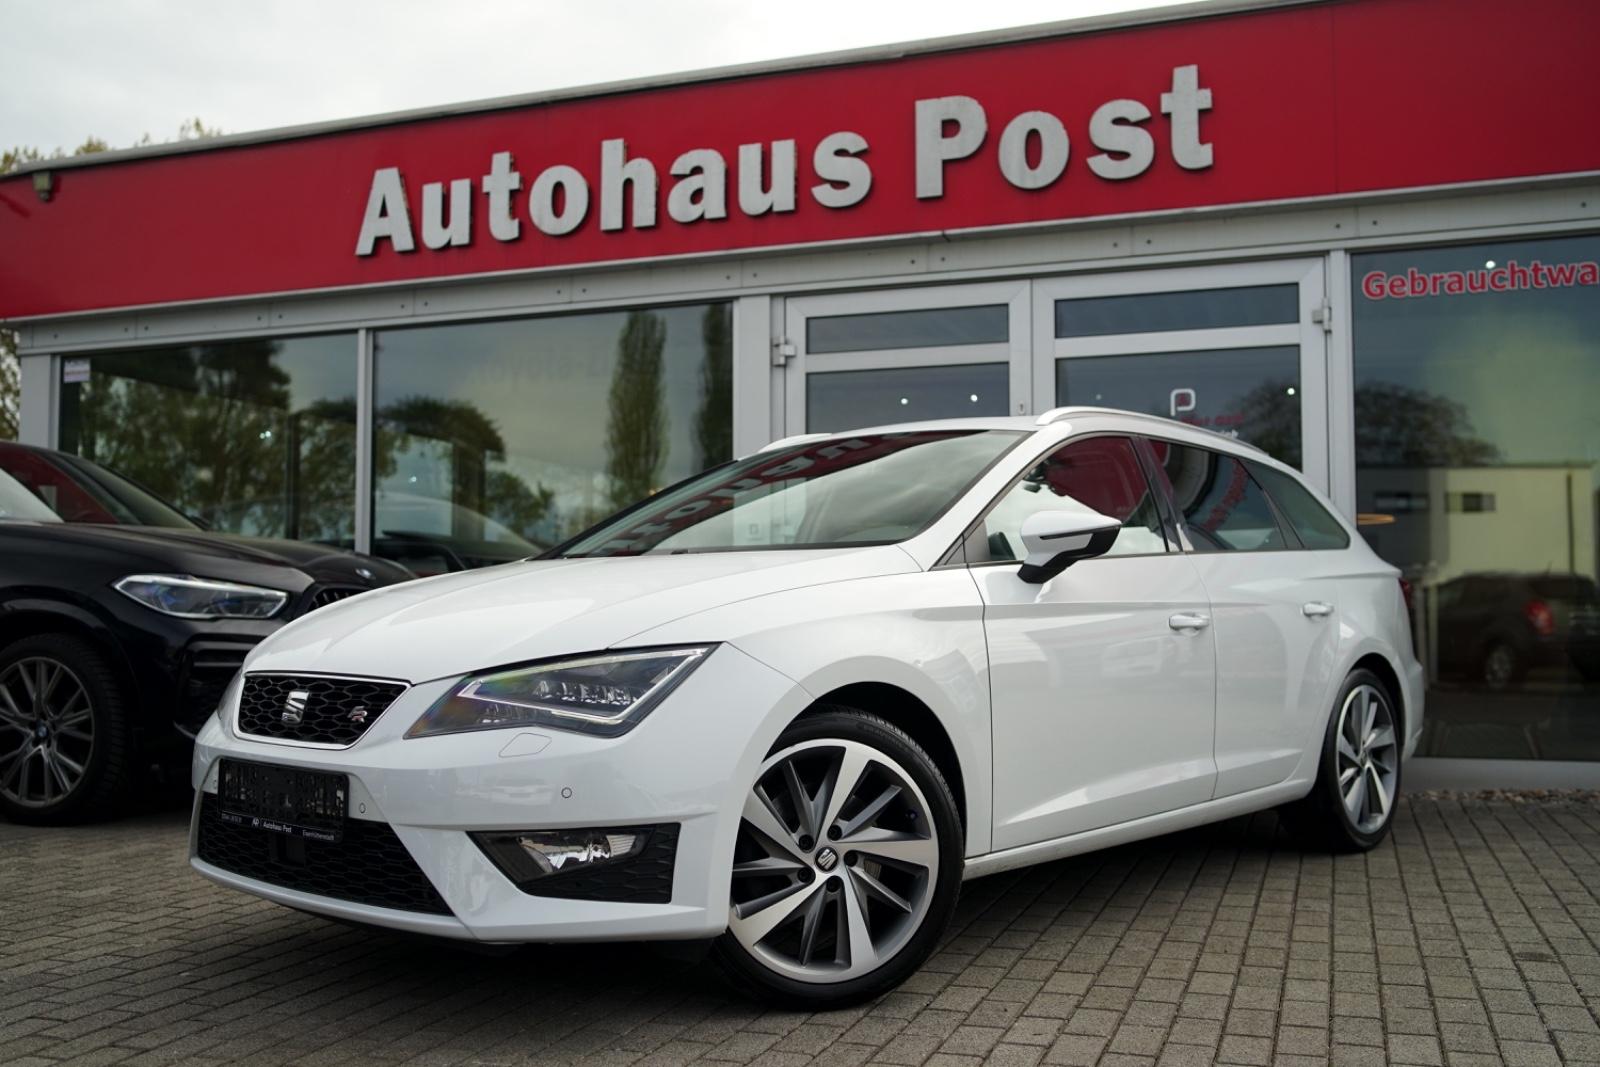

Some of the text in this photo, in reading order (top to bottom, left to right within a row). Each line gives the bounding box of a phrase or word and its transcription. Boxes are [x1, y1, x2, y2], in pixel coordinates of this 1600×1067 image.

[355, 64, 1214, 256] Autohaus Post
[1362, 260, 1600, 300] Gebrauchtwa
